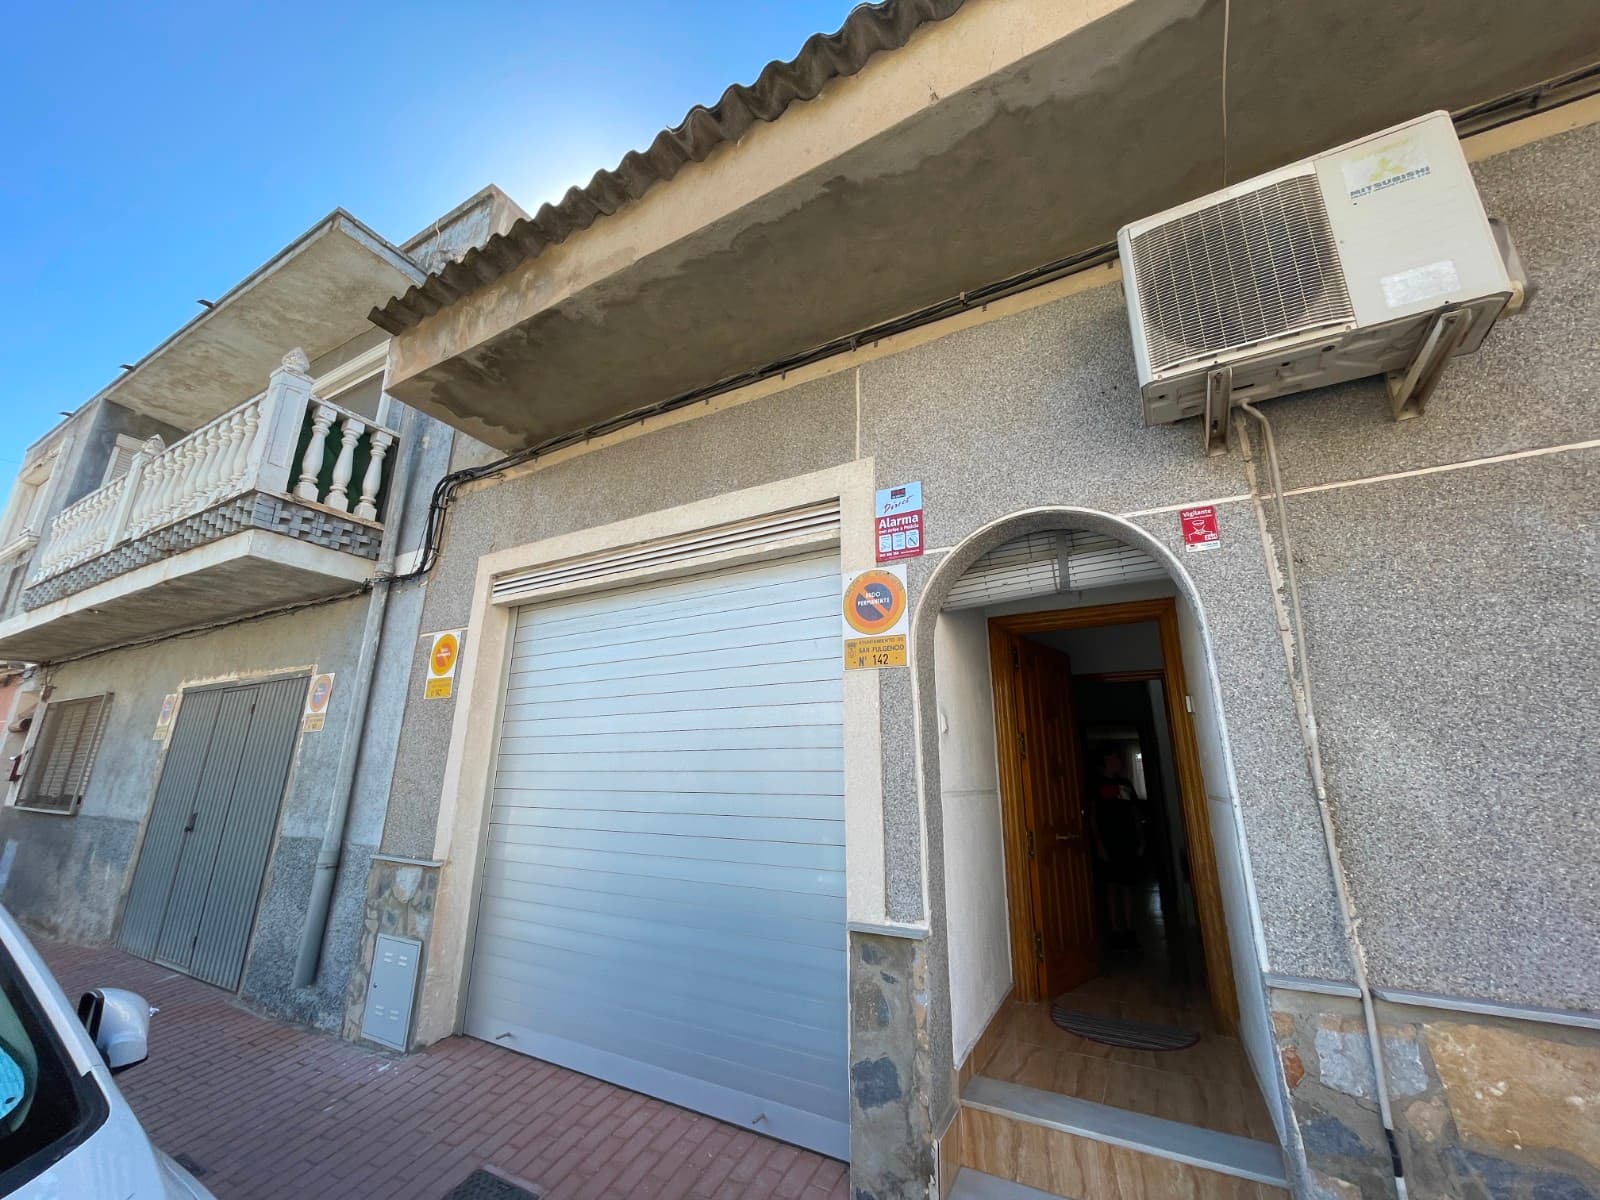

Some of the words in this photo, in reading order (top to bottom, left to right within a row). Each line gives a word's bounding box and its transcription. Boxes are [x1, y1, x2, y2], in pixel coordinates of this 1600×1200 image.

[1350, 166, 1430, 197] MITSUBISHI
[1182, 509, 1211, 517] Vigilante
[879, 514, 919, 529] Alarma
[857, 597, 890, 607] PERMANENTE
[872, 644, 905, 653] FULGENCIO
[873, 653, 889, 665] 142
